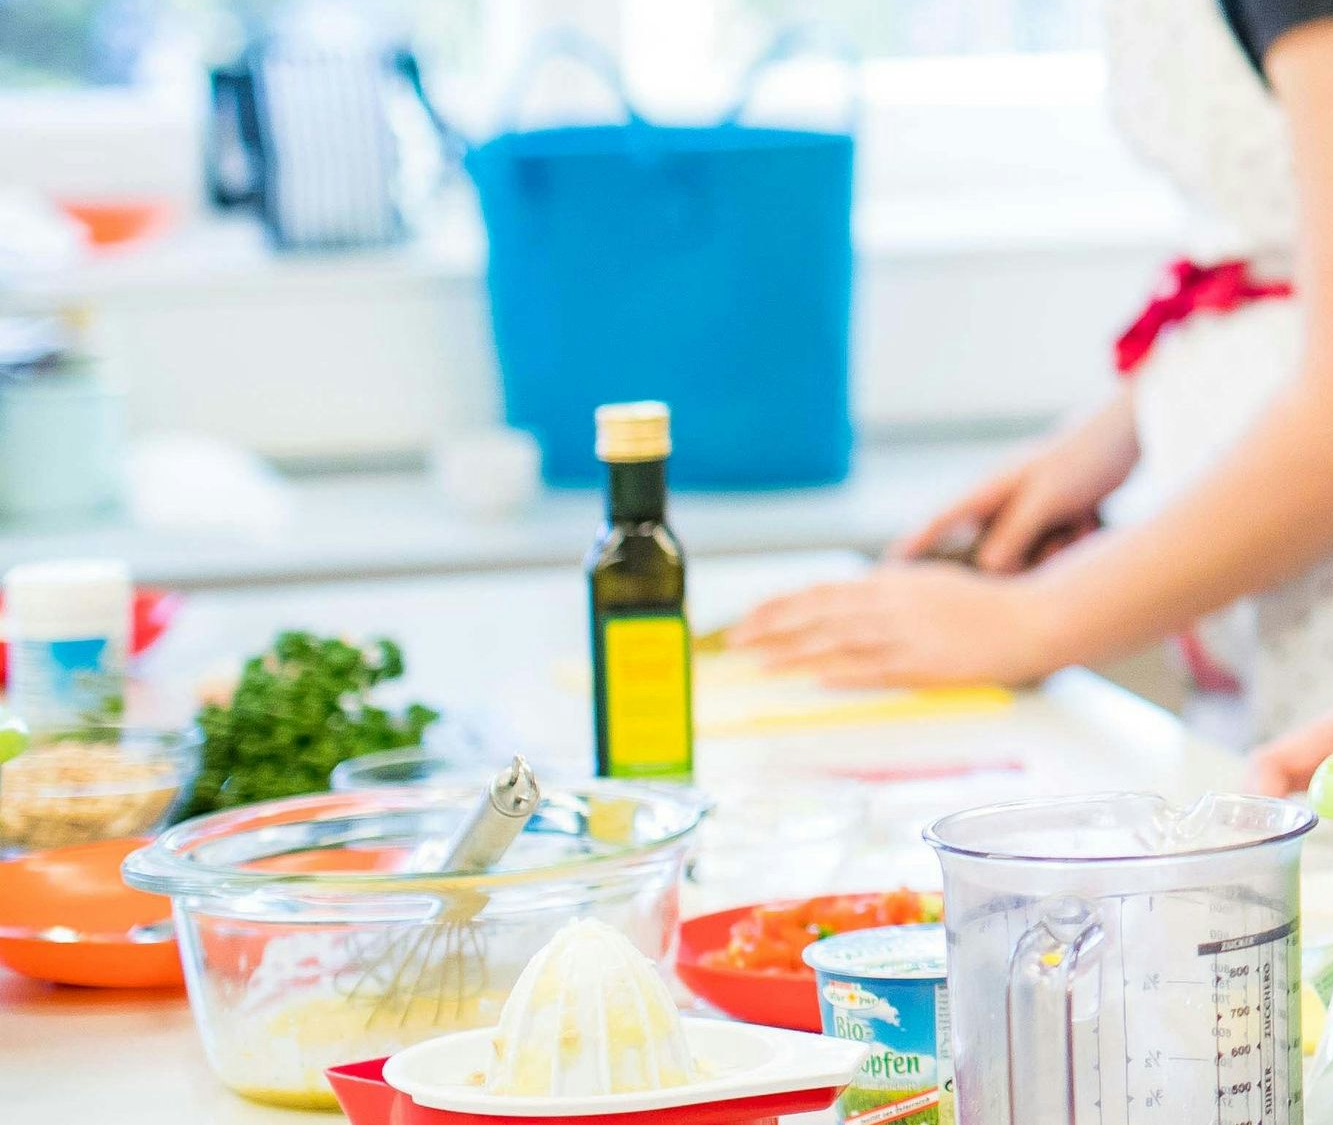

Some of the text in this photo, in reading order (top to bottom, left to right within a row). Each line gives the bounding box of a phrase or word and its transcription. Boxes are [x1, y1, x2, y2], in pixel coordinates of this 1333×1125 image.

[1229, 964, 1249, 978] 800
[1262, 962, 1272, 1038] ZUCCHERO
[1230, 1005, 1250, 1019] 700
[836, 1016, 872, 1041] Bio-
[1231, 1043, 1251, 1058] 600
[1231, 1081, 1252, 1095] 500
[1264, 1066, 1273, 1116] SUIKER
